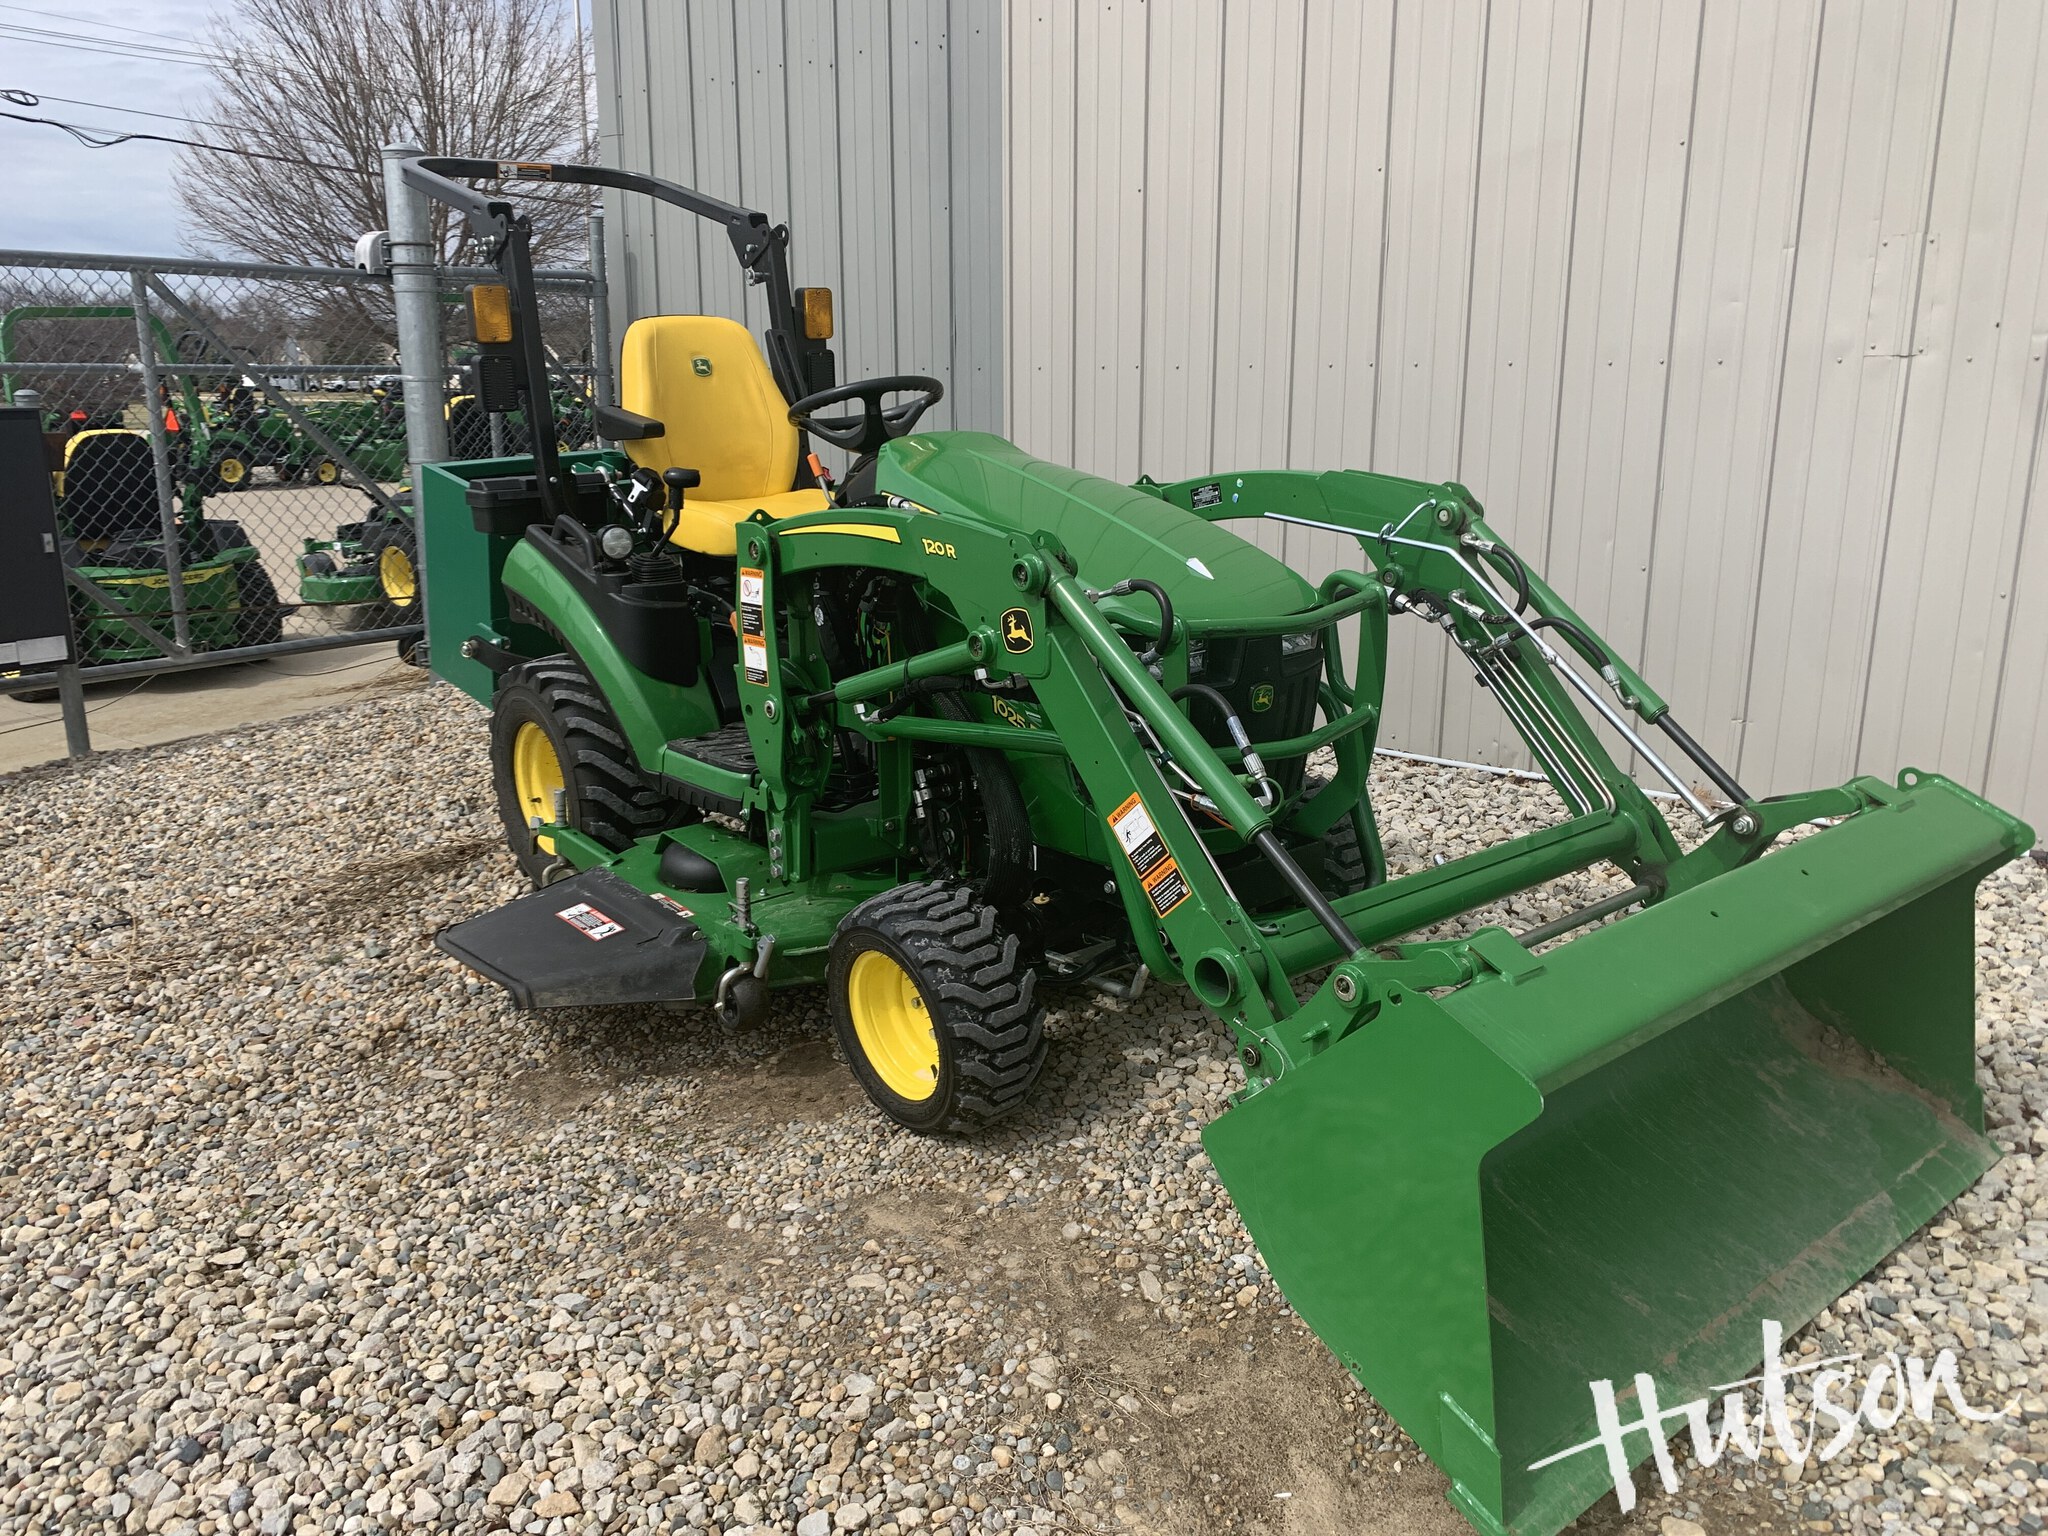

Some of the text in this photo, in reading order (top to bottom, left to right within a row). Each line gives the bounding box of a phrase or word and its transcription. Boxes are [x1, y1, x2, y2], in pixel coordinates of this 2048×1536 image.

[991, 694, 1037, 730] 1025
[1117, 797, 1137, 818] WARNING
[1152, 863, 1173, 883] WARNING
